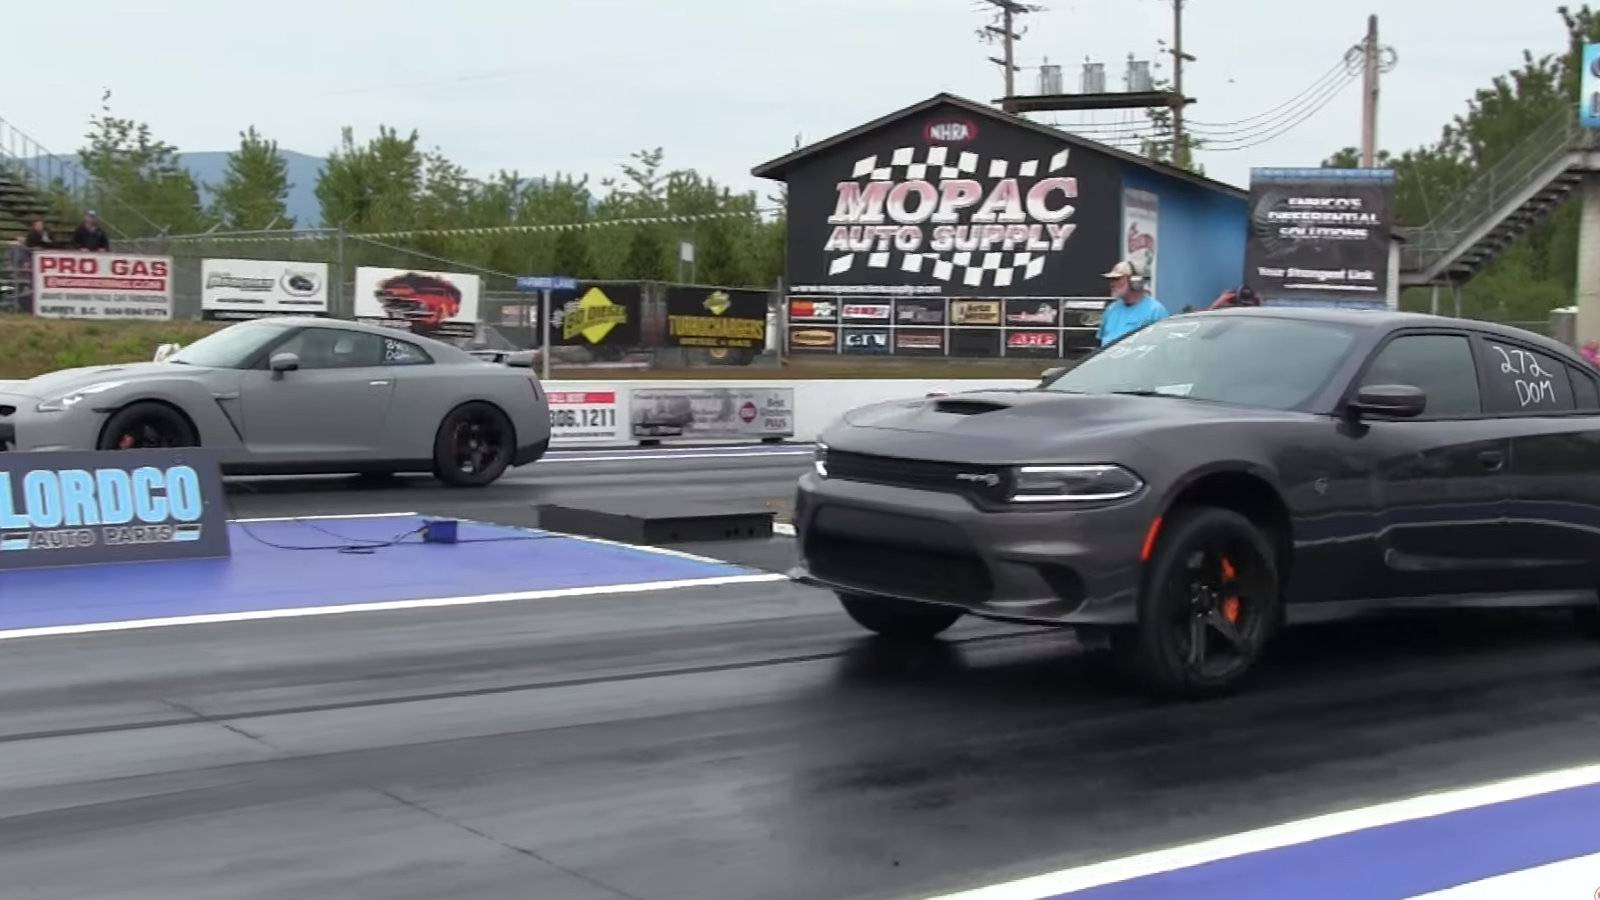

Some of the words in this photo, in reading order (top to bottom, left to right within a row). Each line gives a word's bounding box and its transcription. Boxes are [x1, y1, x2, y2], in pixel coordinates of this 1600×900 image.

[928, 123, 969, 142] NHRA
[827, 177, 1079, 225] MOPAC
[823, 224, 924, 251] AUTO
[930, 223, 1077, 251] SUPPLY
[1279, 226, 1369, 239] SOLUTIONS
[39, 256, 98, 274] PRO
[111, 259, 168, 277] GAS
[1347, 269, 1375, 280] Link
[1492, 346, 1553, 378] 272
[1515, 379, 1557, 407] DOM
[0, 465, 204, 529] LORDCO
[31, 528, 97, 549] AUTO
[103, 524, 177, 545] PARTS
